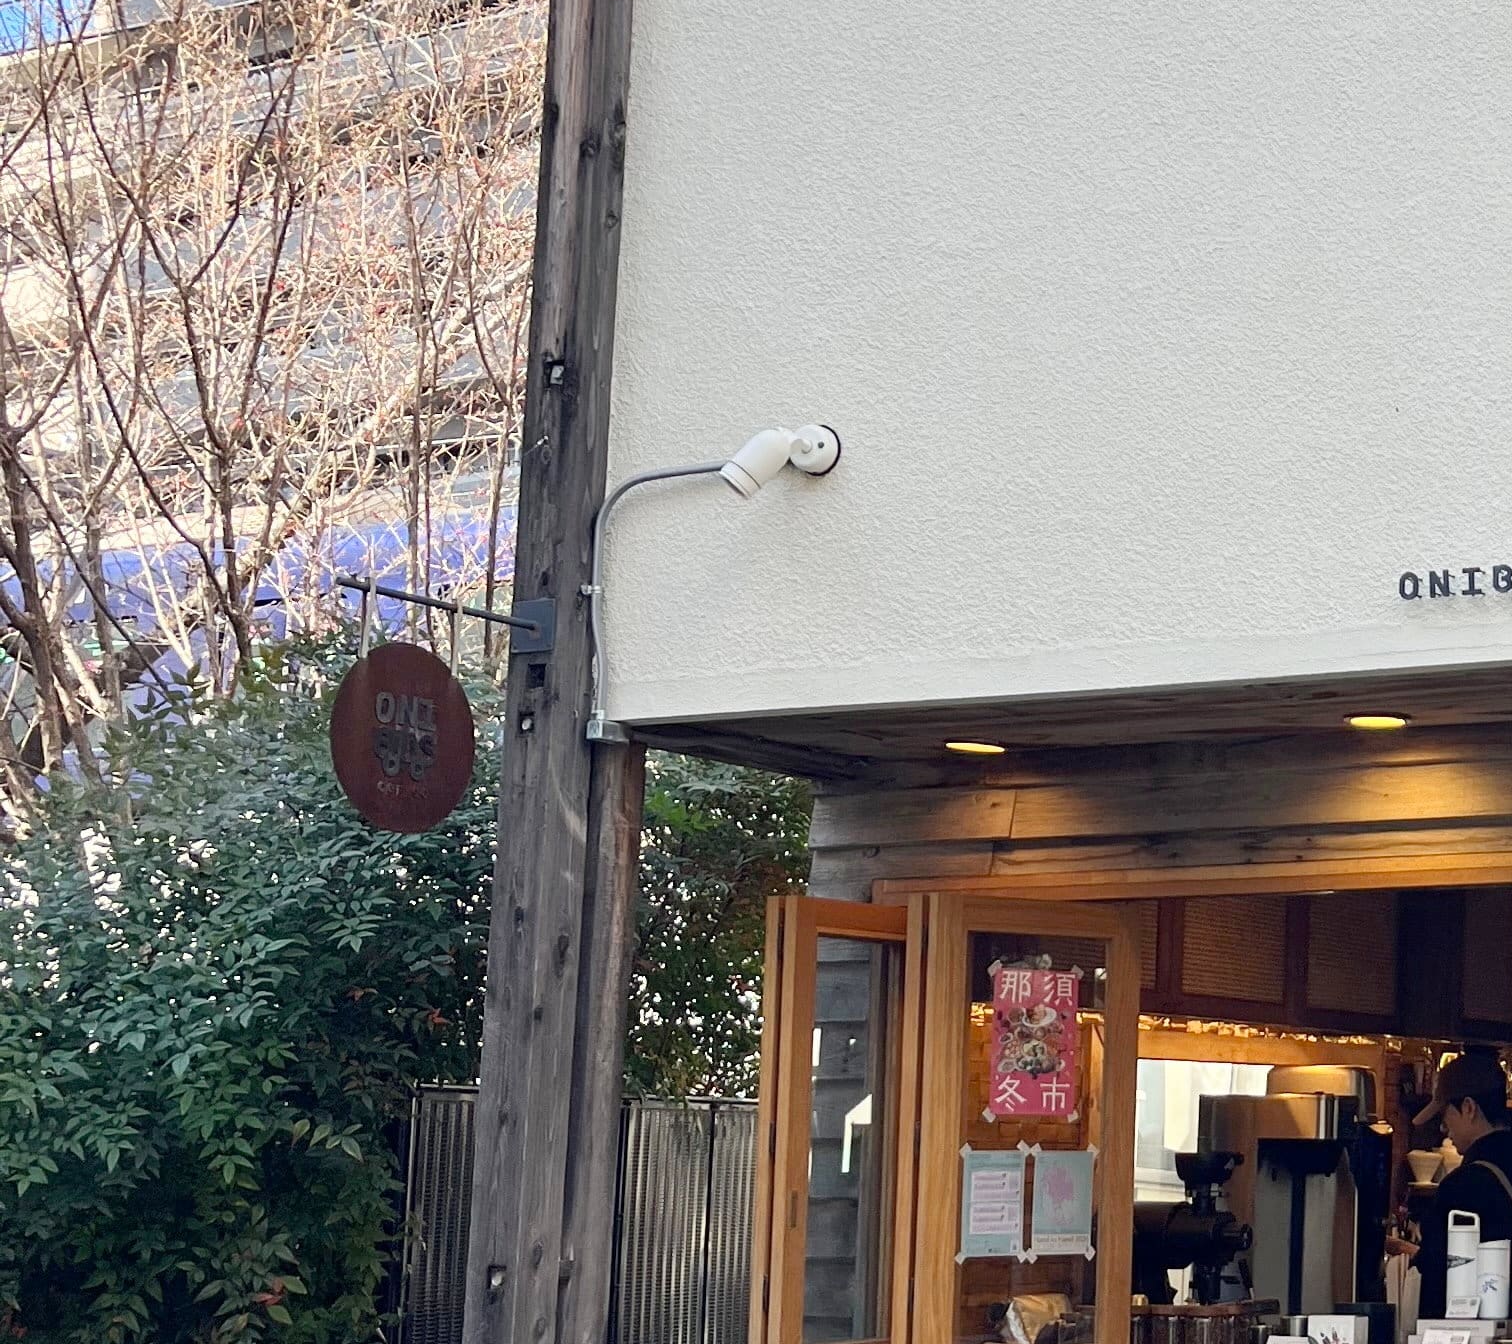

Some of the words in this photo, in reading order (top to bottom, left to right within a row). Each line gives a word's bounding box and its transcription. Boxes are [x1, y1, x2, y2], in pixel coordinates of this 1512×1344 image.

[375, 691, 436, 732] ONI
[1000, 970, 1076, 1006] 那須
[994, 1074, 1071, 1112] 冬市
